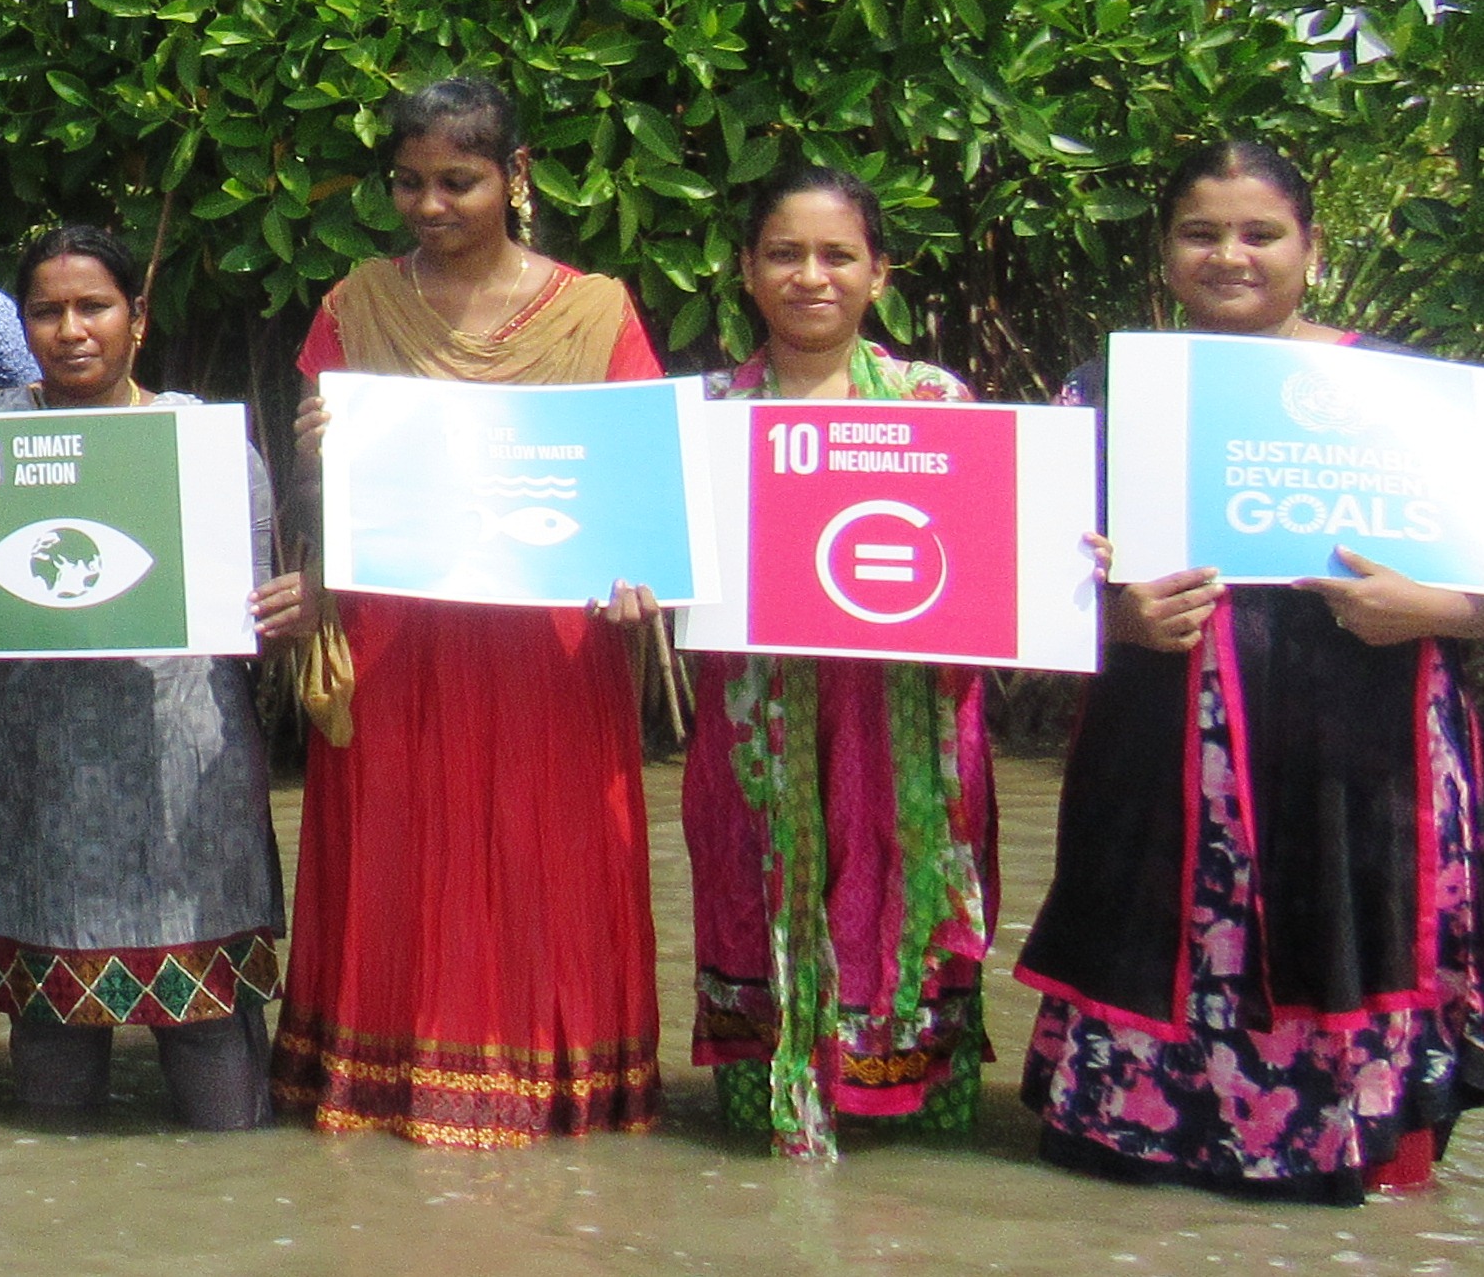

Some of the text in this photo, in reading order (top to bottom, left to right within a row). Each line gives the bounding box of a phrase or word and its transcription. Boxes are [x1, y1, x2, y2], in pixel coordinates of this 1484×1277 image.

[12, 434, 84, 458] CLIMATE
[486, 426, 516, 443] LIFE
[828, 423, 911, 446] REDUCED
[488, 444, 585, 460] BELOW WATER
[767, 422, 819, 475] 10
[14, 462, 76, 487] ACTION
[828, 450, 949, 475] INEQUALITIES
[1225, 491, 1443, 543] GOALS
